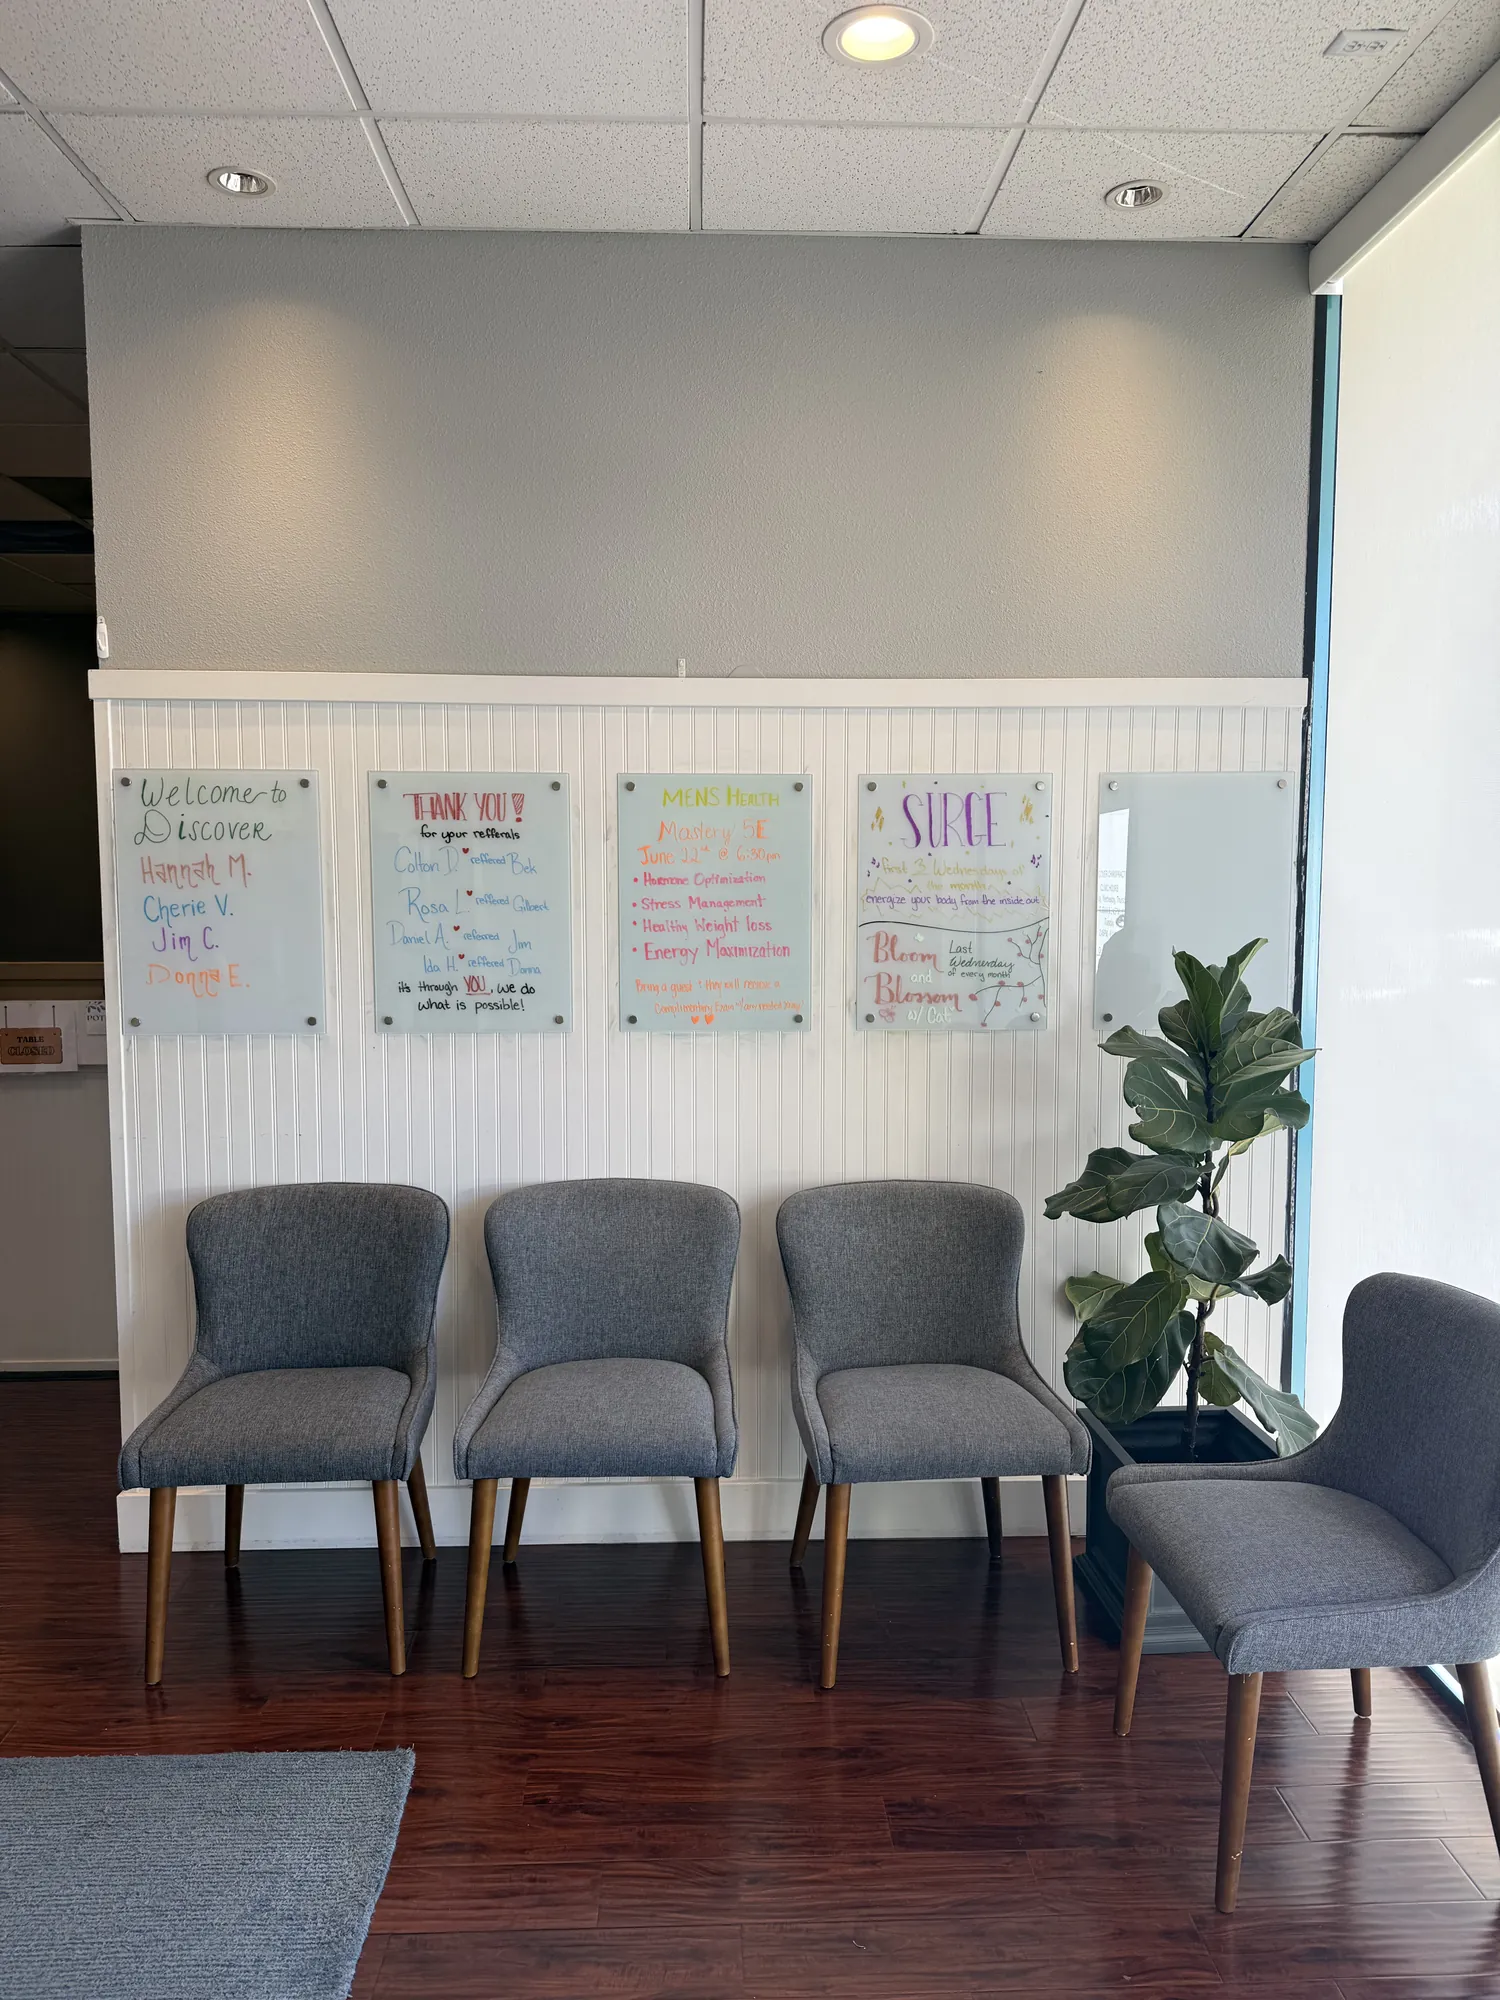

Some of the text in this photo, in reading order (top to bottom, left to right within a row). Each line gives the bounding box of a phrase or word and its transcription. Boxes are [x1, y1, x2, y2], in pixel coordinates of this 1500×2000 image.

[141, 777, 287, 807] Welcome to
[662, 786, 720, 808] MENS
[403, 792, 468, 821] THANK
[900, 791, 1007, 848] SURGE
[420, 824, 437, 839] for
[442, 830, 468, 843] your
[657, 820, 736, 846] Mastery
[394, 846, 440, 874] Colton
[439, 846, 459, 876] D.
[507, 852, 537, 875] Bek
[637, 845, 674, 865] June
[718, 848, 729, 861] @
[140, 853, 252, 889] Hannah M.
[643, 871, 766, 888] Hormone Optimization
[933, 859, 1008, 880] Wednesdays
[927, 880, 987, 891] the month
[143, 894, 233, 928] Cherie V.
[399, 886, 449, 923] Rosa
[513, 895, 550, 912] Gilbert
[641, 894, 766, 912] Stress Management
[866, 894, 1040, 911] energize your body from the inside out
[386, 920, 431, 947] Daniel
[435, 922, 451, 950] A.
[643, 919, 688, 936] Healthy
[694, 916, 740, 938] Weight
[152, 926, 219, 961] Jim C.
[644, 937, 791, 966] Energy Maximization
[866, 930, 944, 972] Bloom
[949, 940, 972, 954] Last
[424, 955, 441, 974] Ida
[446, 955, 459, 973] H.
[507, 957, 542, 977] Donna
[948, 968, 1011, 982] of every month
[949, 956, 1014, 973] Wednesday
[146, 964, 250, 998] Donna E.
[910, 969, 932, 984] and
[418, 981, 459, 996] through
[497, 984, 516, 994] we
[521, 982, 536, 995] do
[635, 978, 660, 996] Bring
[661, 983, 668, 992] a
[670, 980, 693, 999] guest
[724, 978, 740, 990] will
[774, 980, 780, 989] a
[864, 972, 962, 1012] Blossom
[418, 998, 525, 1014] what is possible!
[7, 1046, 55, 1056] CLOSED
